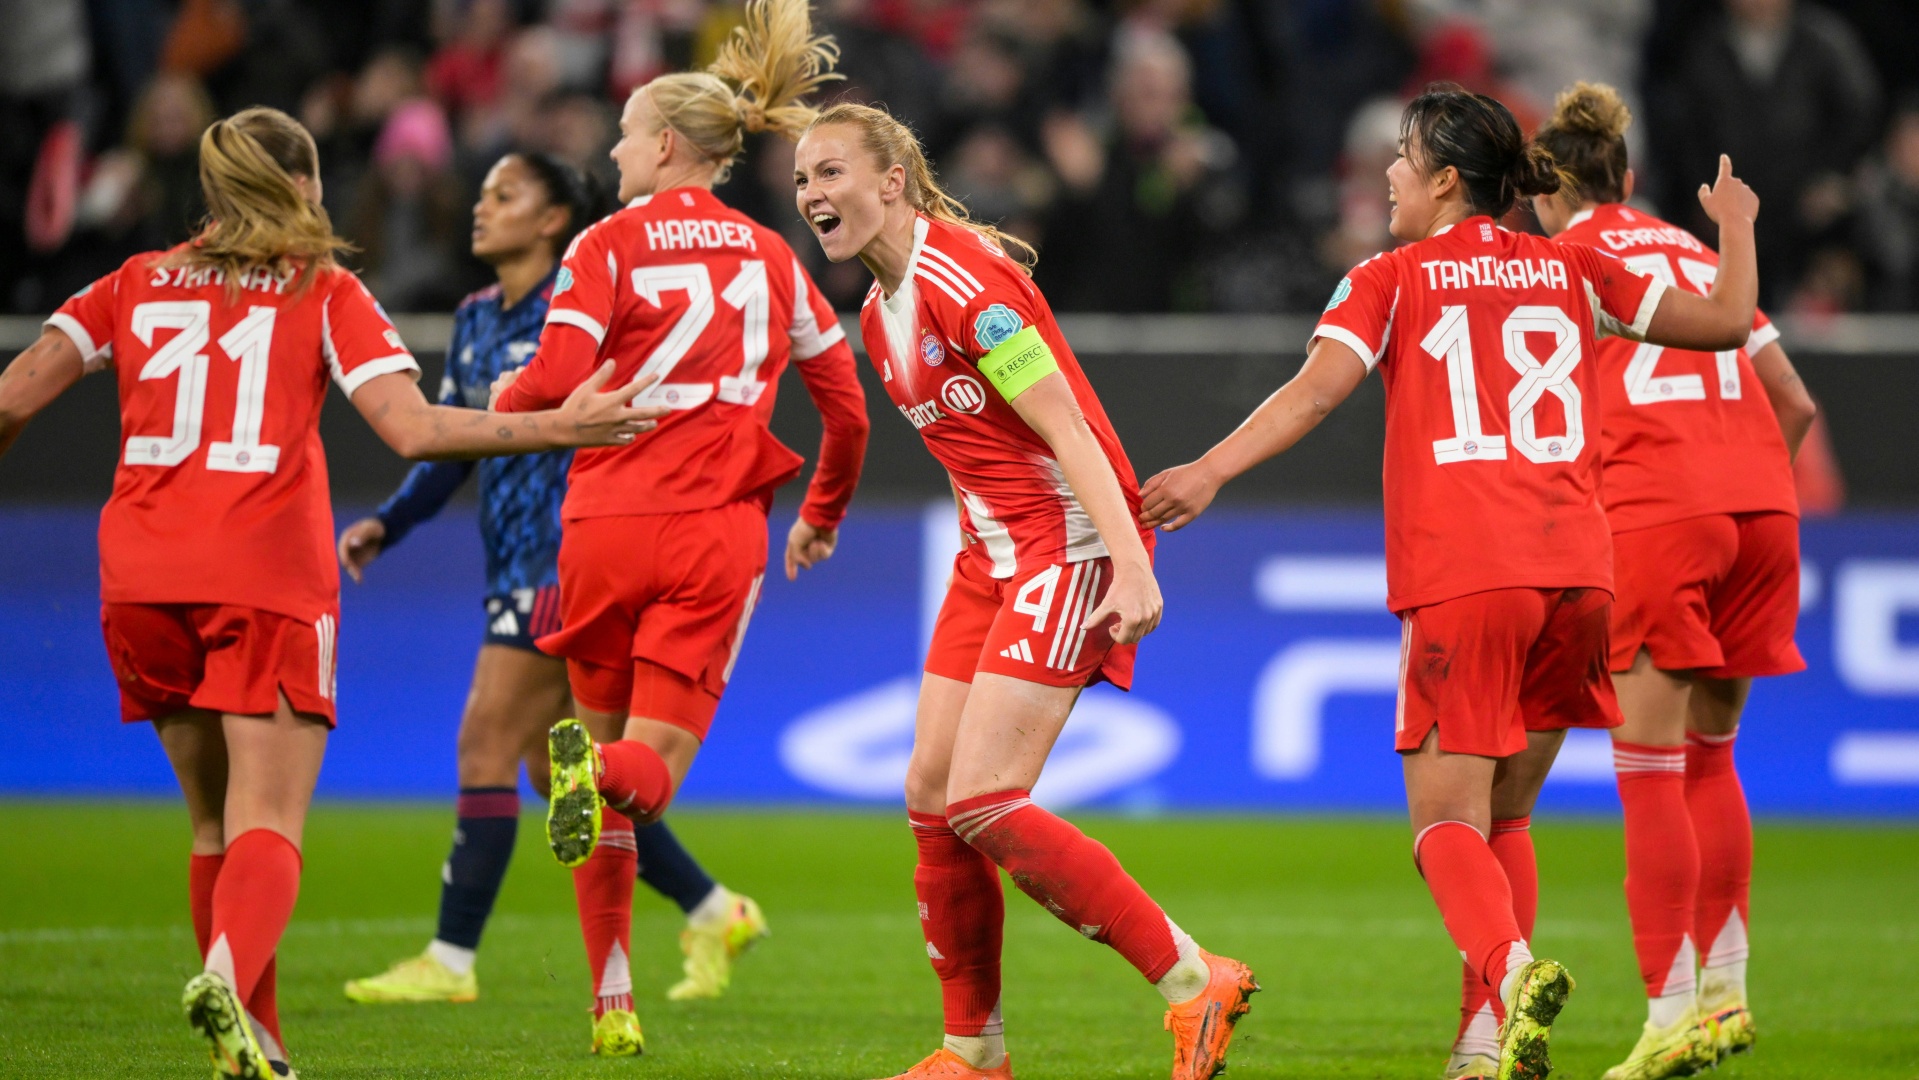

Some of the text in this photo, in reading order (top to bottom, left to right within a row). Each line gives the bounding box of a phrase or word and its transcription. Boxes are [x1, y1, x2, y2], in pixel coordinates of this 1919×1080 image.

[644, 219, 757, 252] HARDER
[1420, 255, 1568, 291] TANIKAWA
[630, 260, 770, 410] 21
[1007, 345, 1044, 373] RESPECT
[124, 300, 281, 475] 31
[1419, 305, 1585, 465] 18
[1013, 563, 1063, 633] 4
